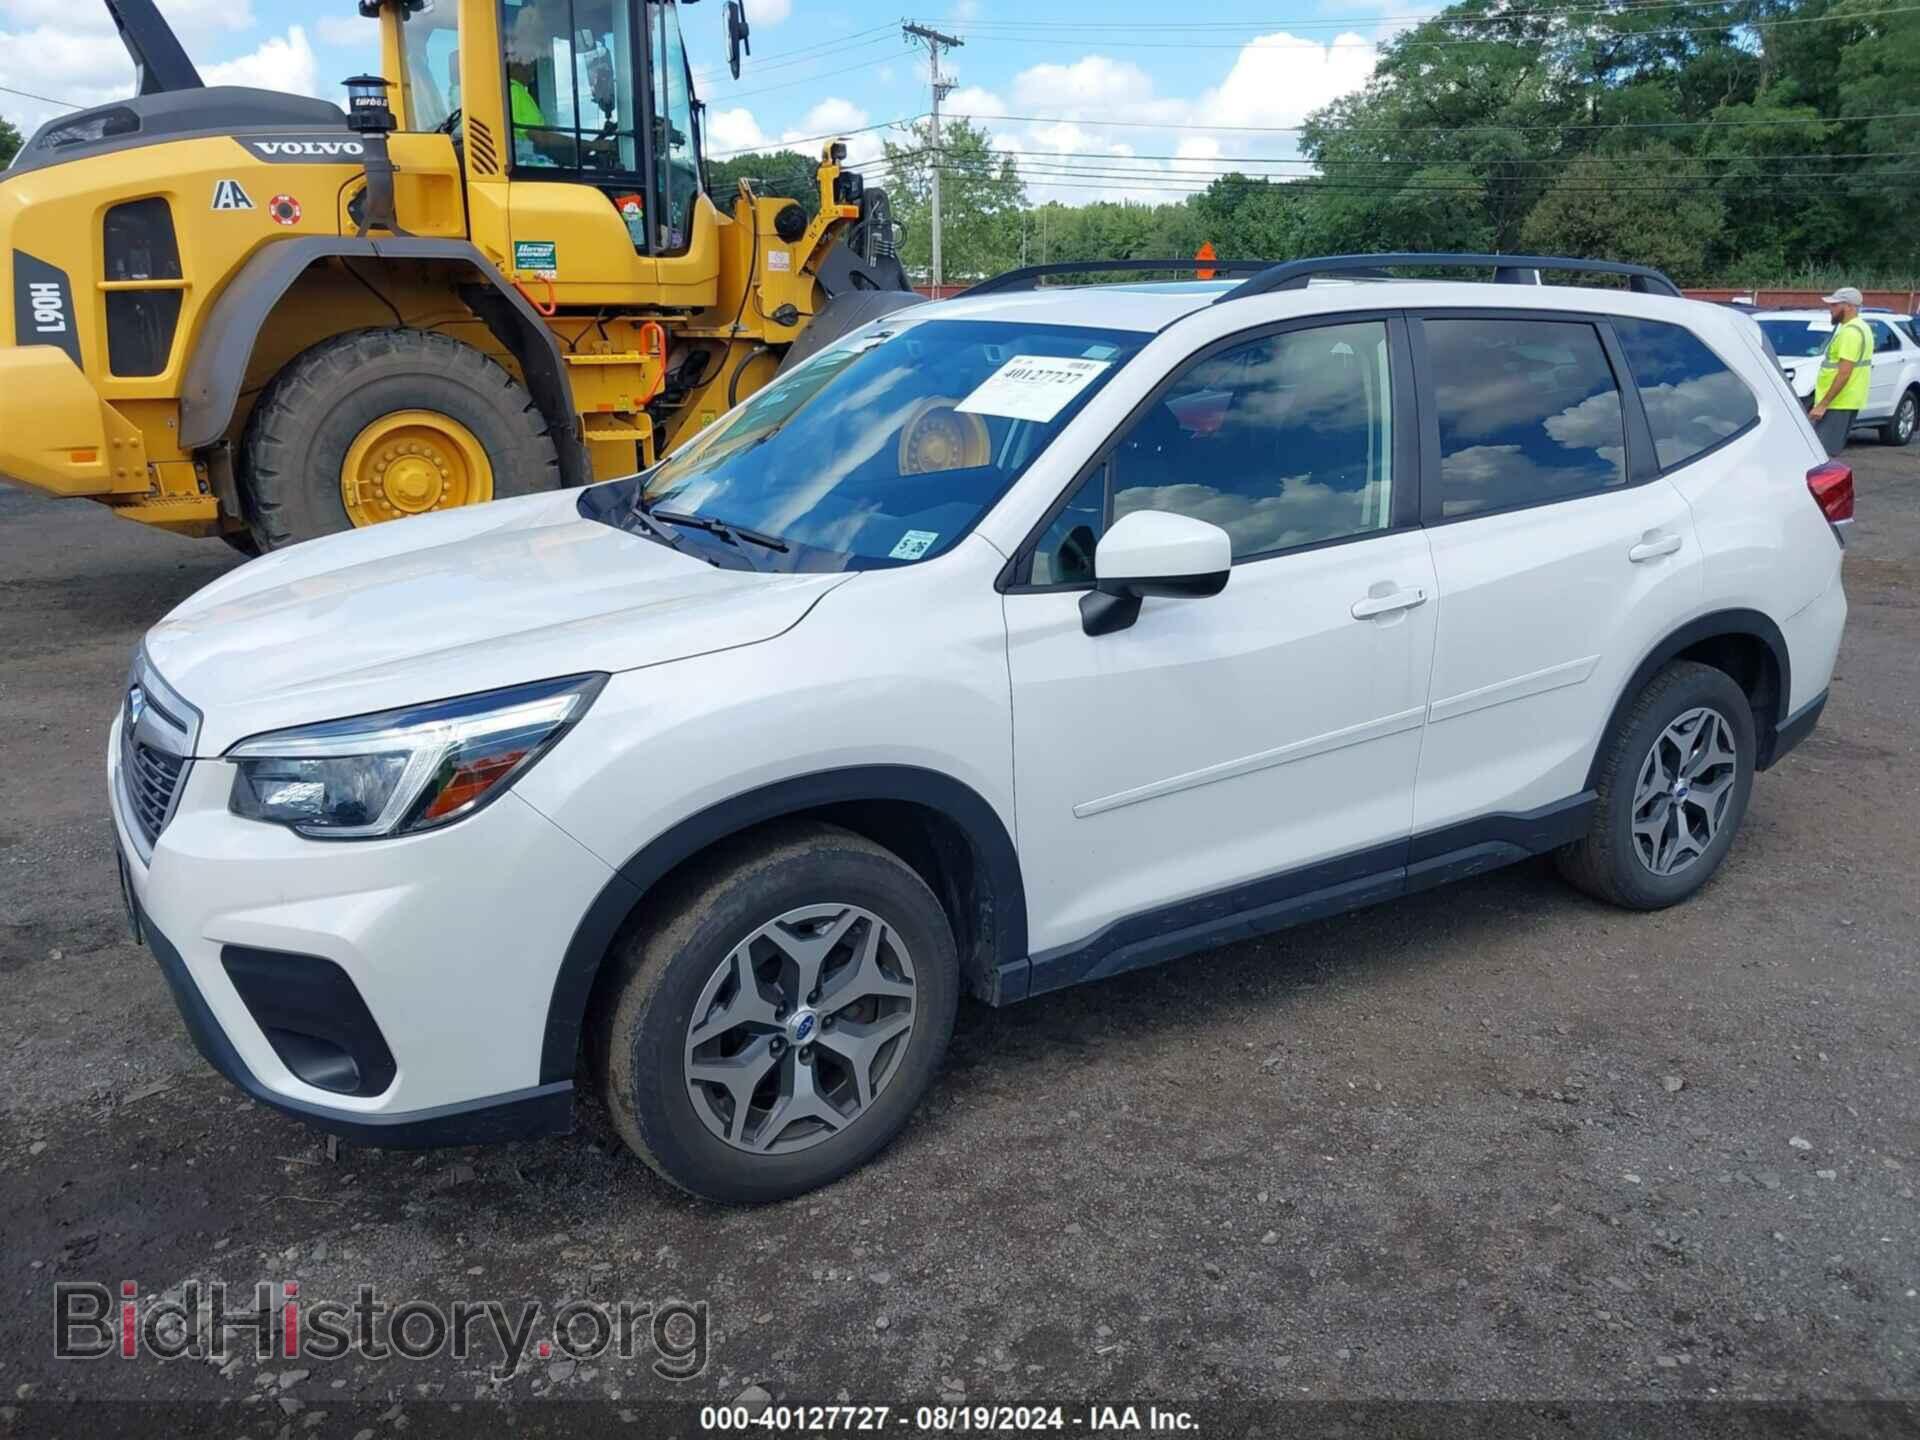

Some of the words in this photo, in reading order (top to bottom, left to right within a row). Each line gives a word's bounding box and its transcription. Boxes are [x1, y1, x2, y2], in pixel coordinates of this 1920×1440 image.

[254, 142, 364, 155] VOLVO
[29, 283, 66, 332] L90H
[1004, 368, 1084, 384] 40127727
